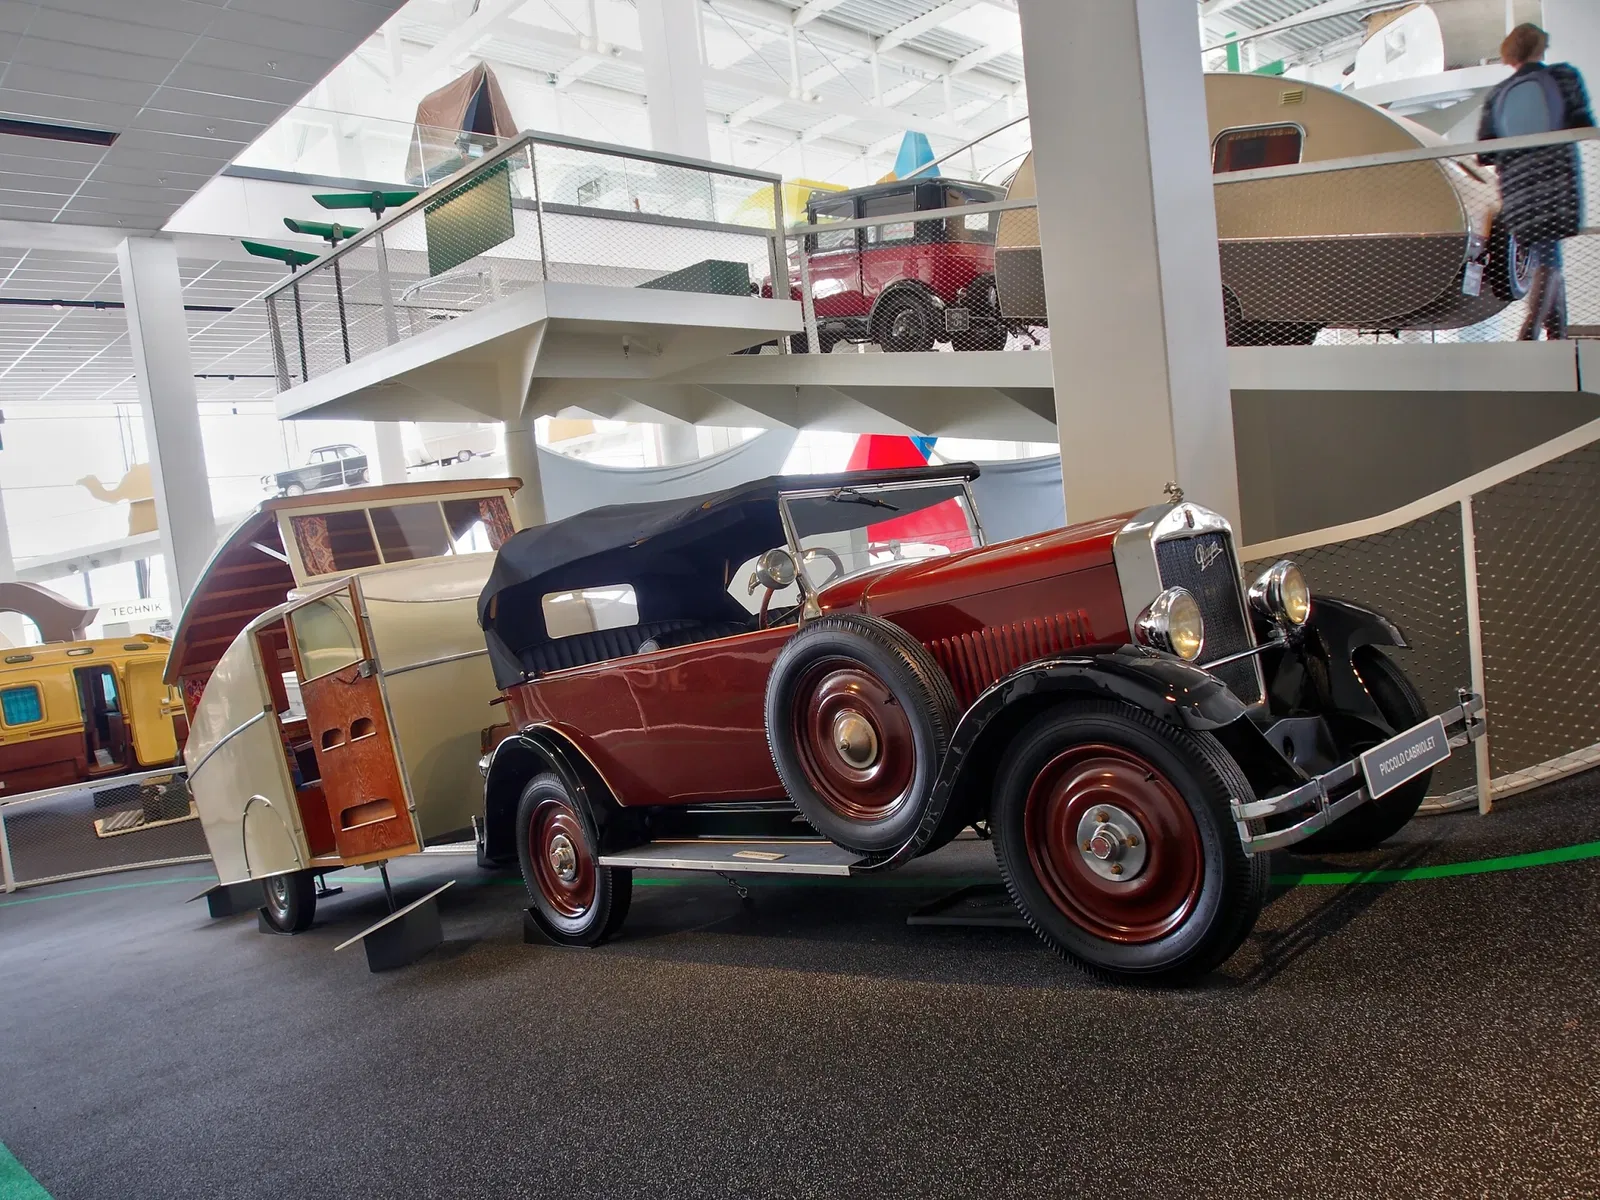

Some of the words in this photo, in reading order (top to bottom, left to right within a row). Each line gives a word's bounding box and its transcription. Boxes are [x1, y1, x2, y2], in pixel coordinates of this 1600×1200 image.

[112, 603, 162, 616] TECHNIK
[1379, 753, 1406, 776] PICCOLO
[1405, 736, 1436, 761] CABRIOLET
